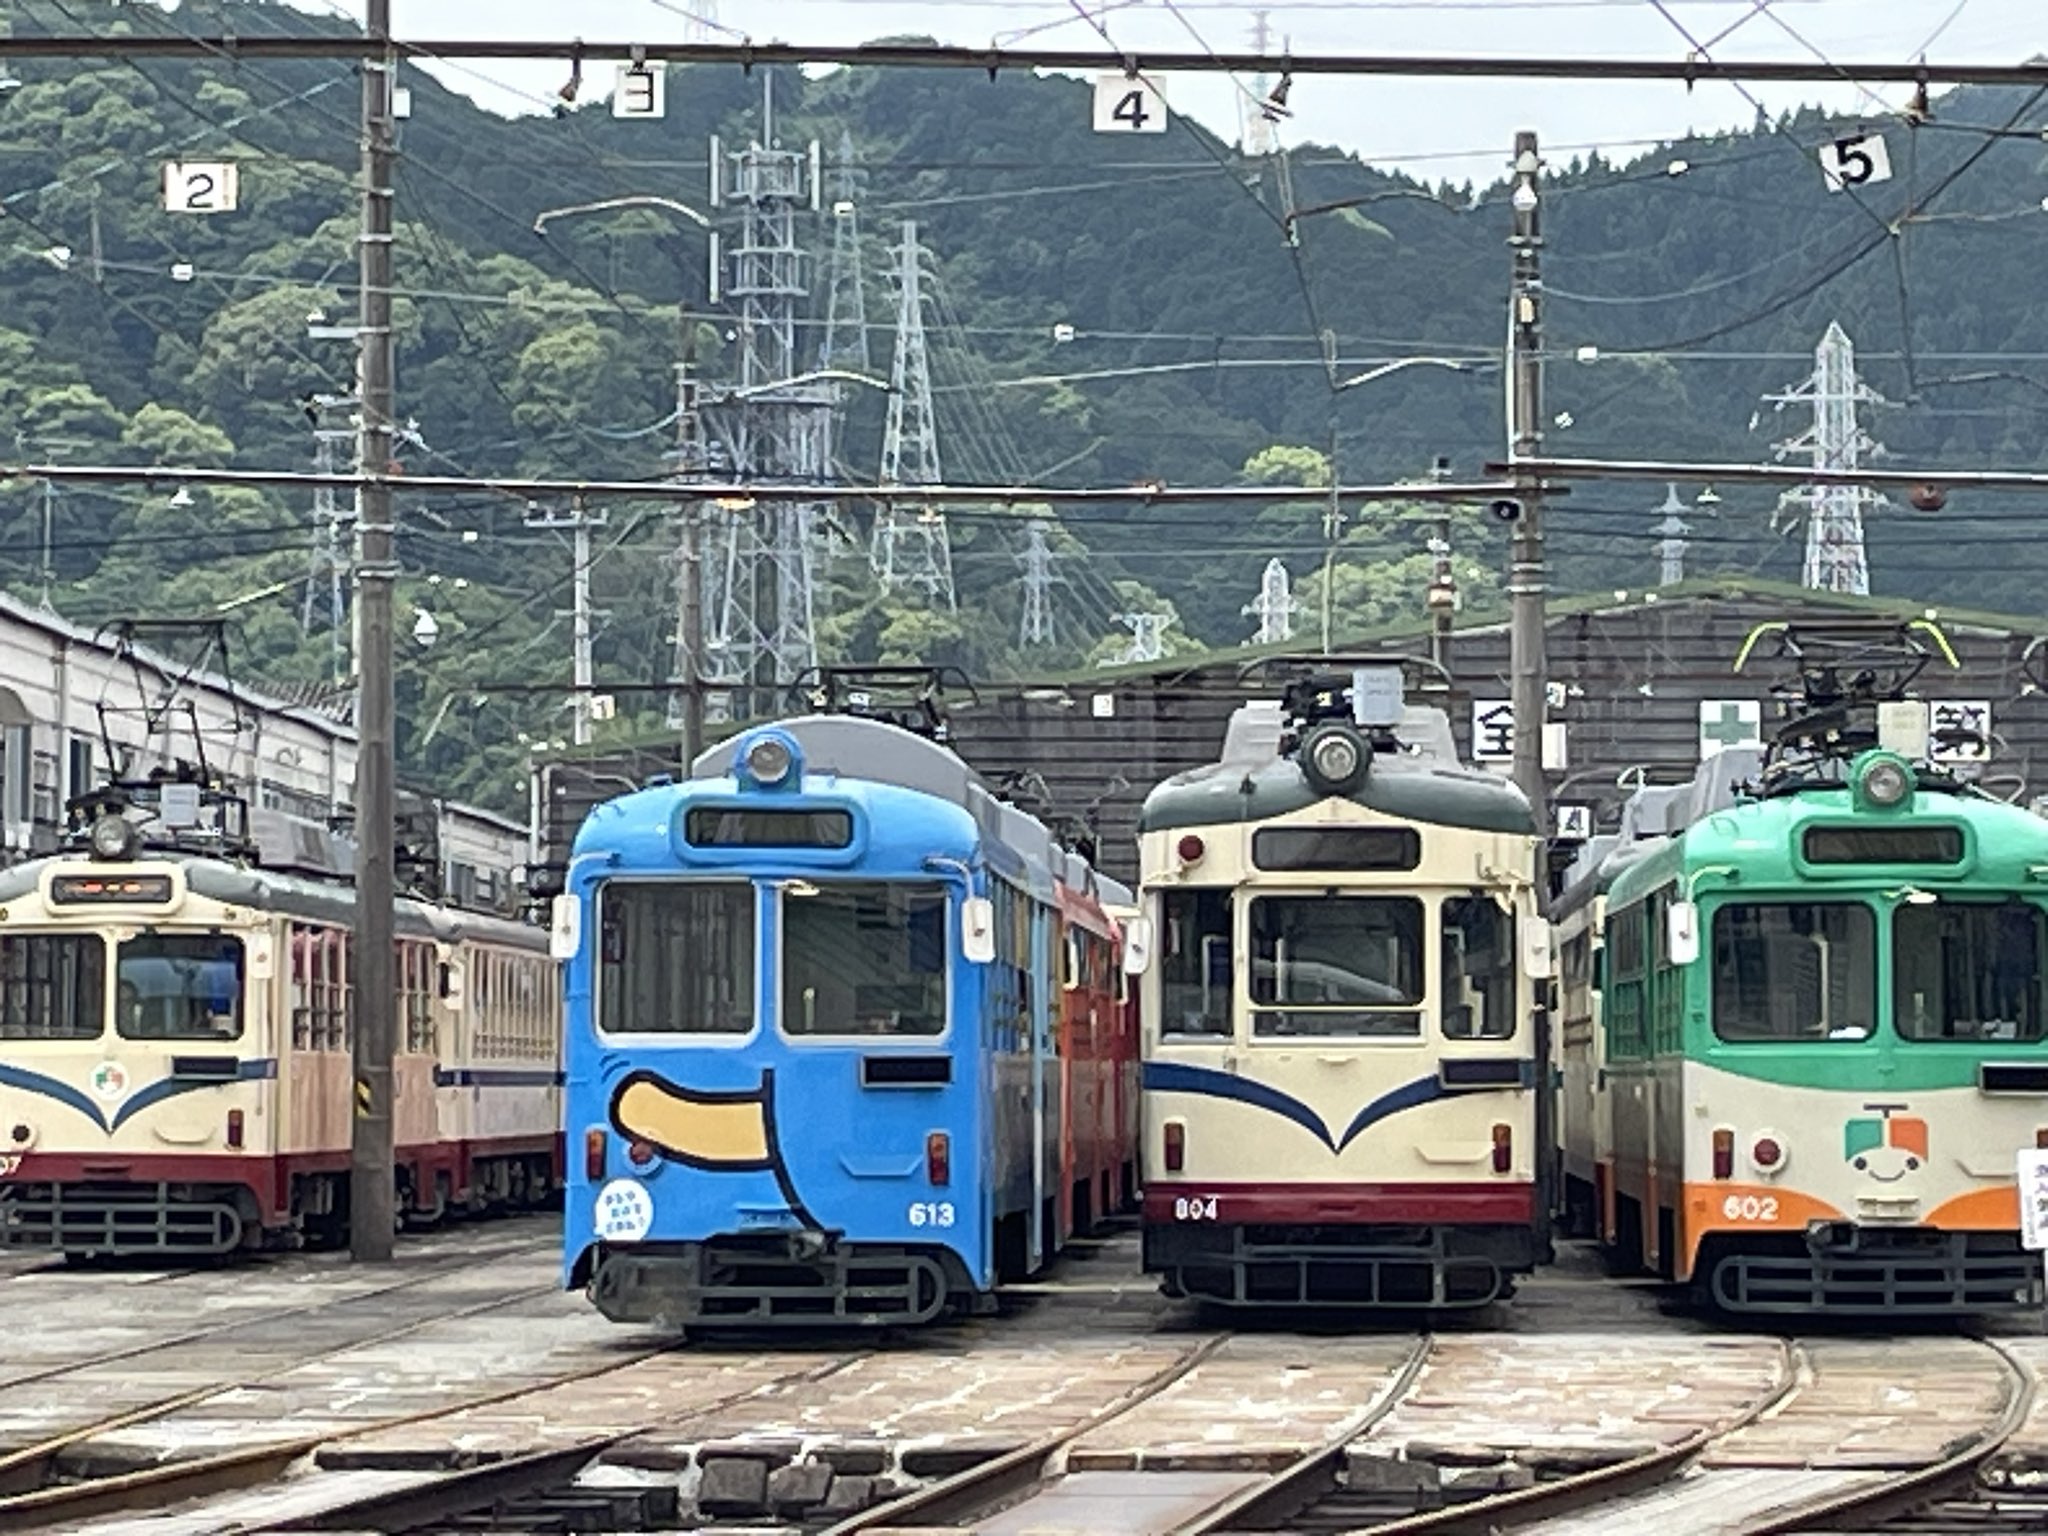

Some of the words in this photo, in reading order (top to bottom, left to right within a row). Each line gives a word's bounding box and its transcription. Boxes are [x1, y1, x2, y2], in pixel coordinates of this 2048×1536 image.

[625, 70, 654, 113] 3
[1112, 90, 1149, 129] 4
[1835, 135, 1874, 184] 5
[186, 173, 214, 209] 2
[1565, 808, 1584, 833] 4
[909, 1202, 955, 1228] 613
[1723, 1195, 1779, 1221] 602
